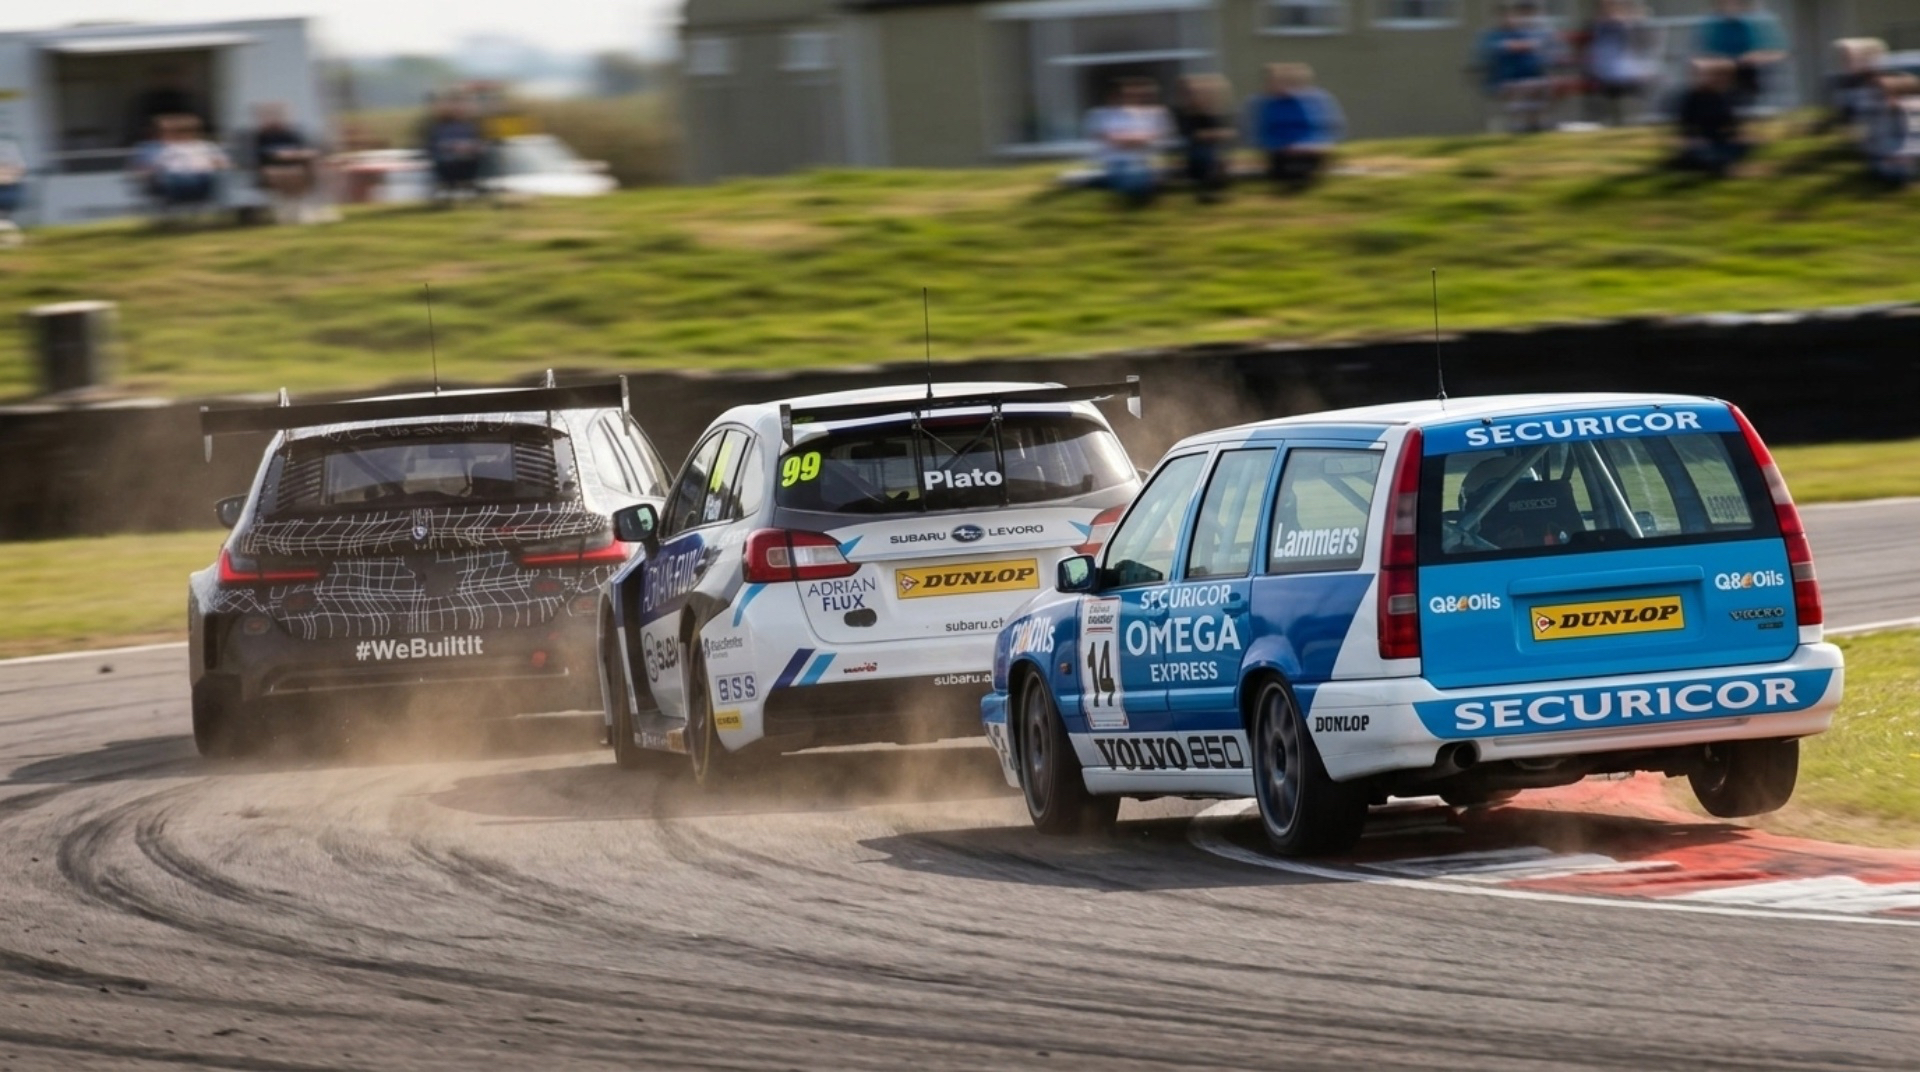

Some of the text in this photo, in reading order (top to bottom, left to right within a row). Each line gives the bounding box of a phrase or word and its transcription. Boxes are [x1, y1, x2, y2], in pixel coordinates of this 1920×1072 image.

[1465, 410, 1701, 447] SECURICOR
[781, 452, 821, 488] 99
[923, 467, 1002, 491] Plato
[890, 532, 947, 544] SUBARU
[1274, 522, 1359, 558] Lammers
[807, 577, 876, 598] ADRIAN
[922, 567, 1035, 589] DUNLOP
[822, 594, 865, 612] FLUX
[1140, 585, 1232, 610] SECURICOR
[1559, 605, 1679, 629] DUNLOP
[356, 635, 484, 661] #WeBuiltIt
[1125, 615, 1241, 656] OMEGA
[1087, 640, 1115, 707] 14
[1150, 661, 1218, 682] EXPRESS
[1455, 677, 1799, 732] SECURICOR
[1315, 715, 1370, 732] DUNLOP
[1094, 735, 1244, 770] VOLVO 850
